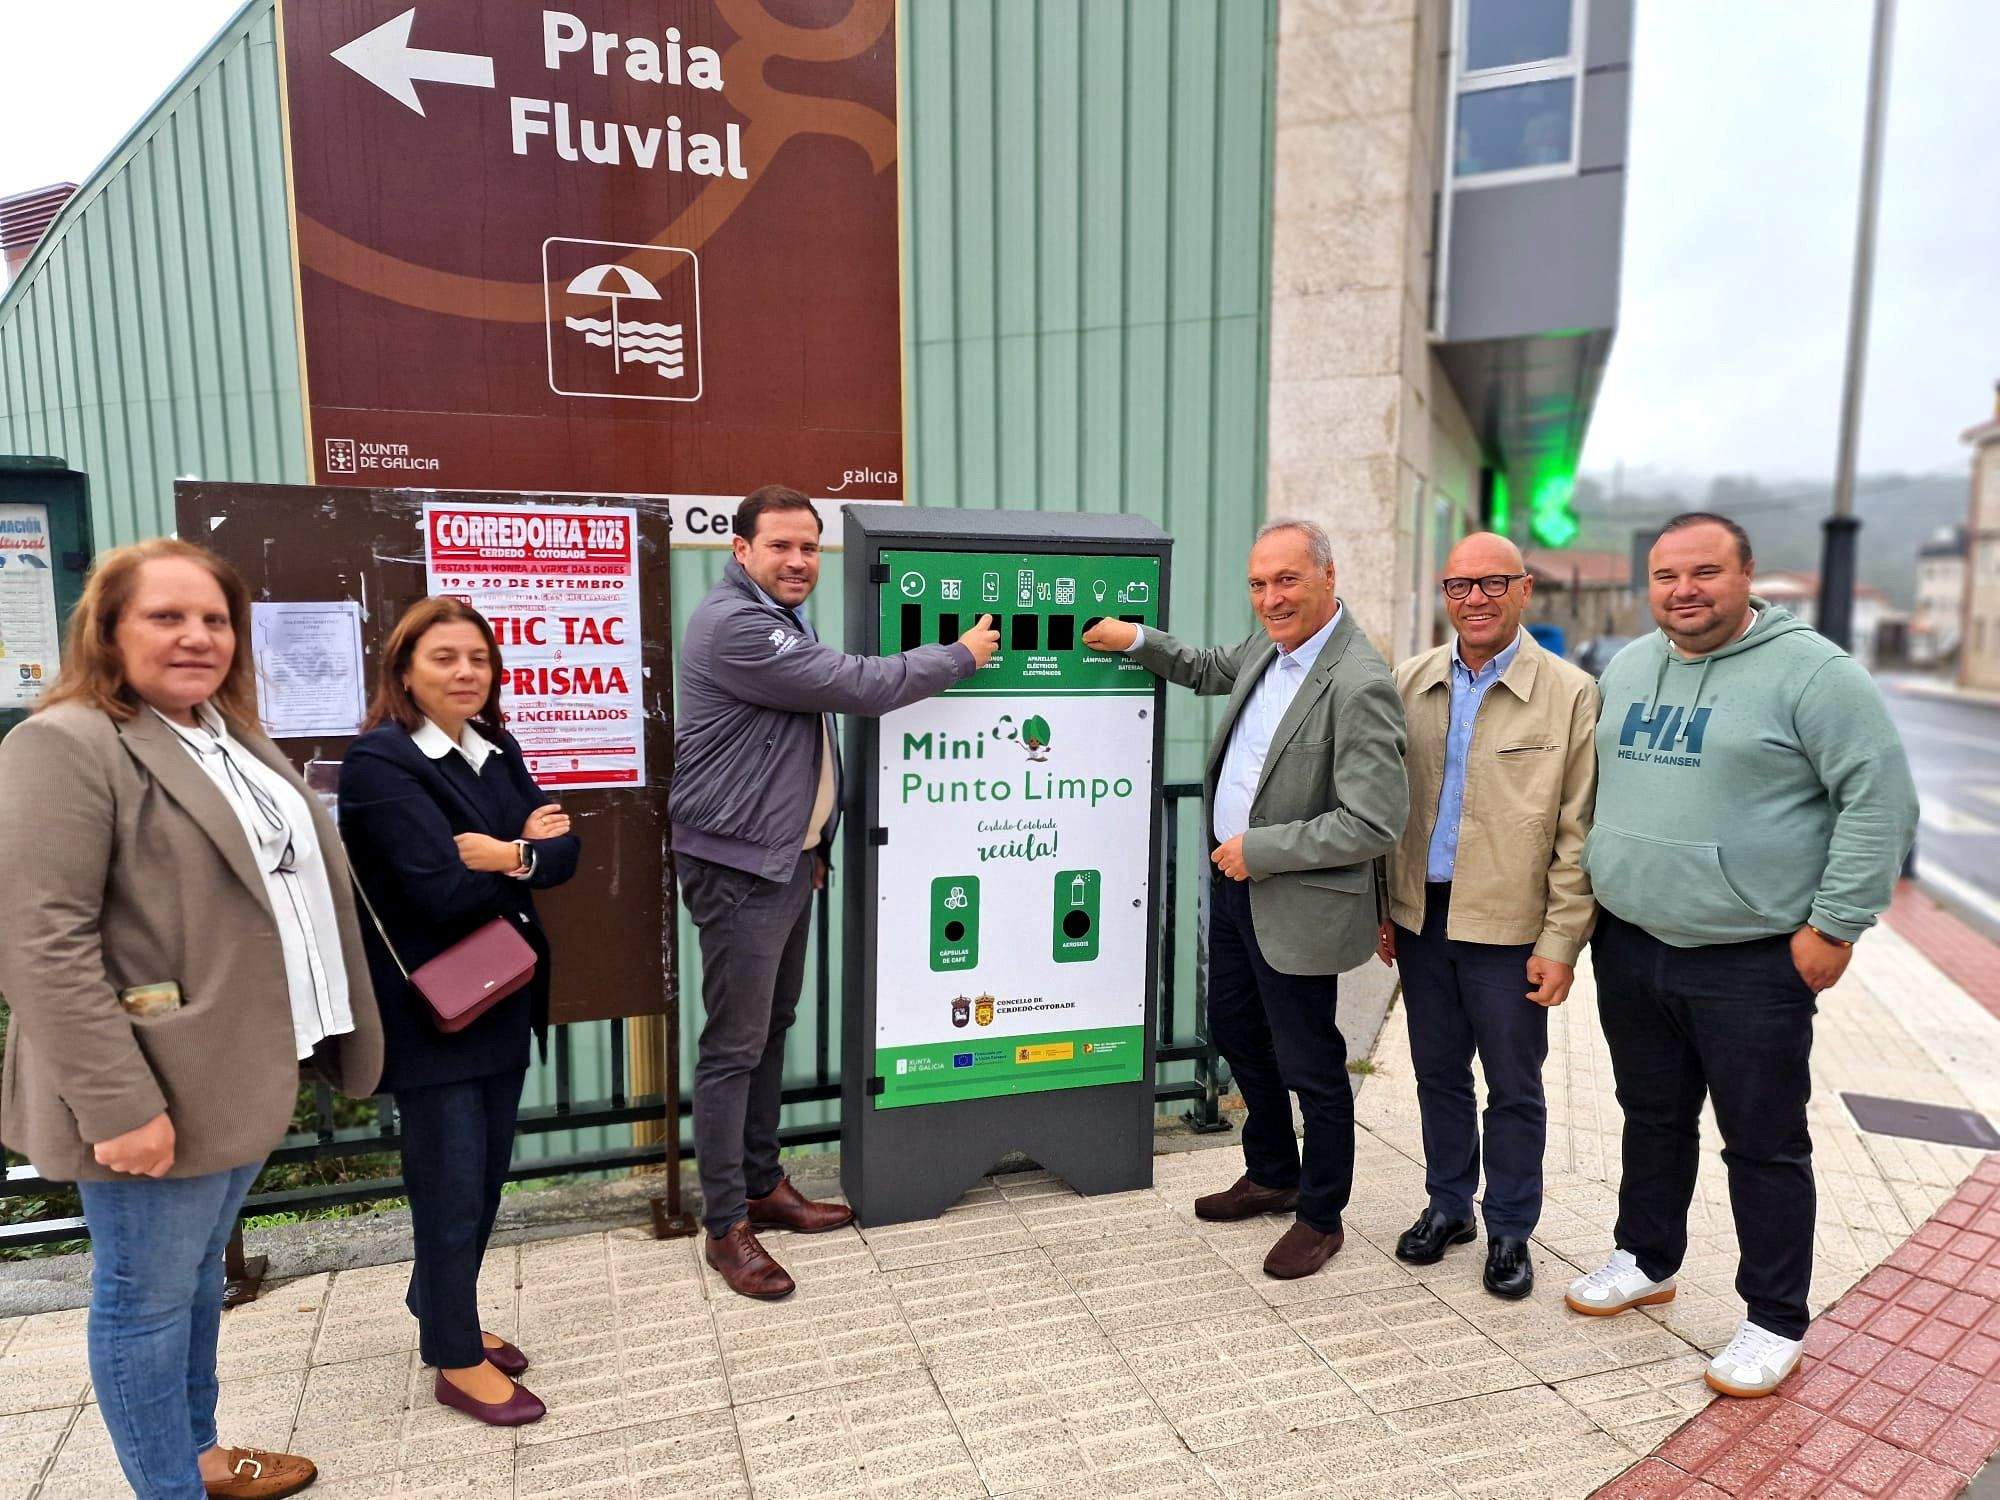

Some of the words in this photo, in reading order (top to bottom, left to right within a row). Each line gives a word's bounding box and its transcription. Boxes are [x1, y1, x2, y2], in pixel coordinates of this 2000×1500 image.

[543, 10, 725, 92] Praia
[510, 96, 748, 180] Fluvial
[360, 443, 408, 456] XUNTA
[360, 457, 378, 468] DE
[381, 458, 440, 470] GALICIA
[826, 466, 898, 491] galicia
[436, 515, 584, 549] CORREDOIRA
[587, 519, 625, 550] 2025
[479, 548, 525, 558] CERDEDO
[534, 549, 586, 559] COTOBADE
[435, 563, 471, 573] FESTAS
[474, 564, 488, 573] NA
[531, 564, 538, 573] A
[540, 564, 569, 573] VIRXE
[572, 565, 590, 574] DAS
[593, 565, 625, 574] DORES
[442, 578, 460, 588] 19
[467, 580, 476, 588] e
[482, 578, 502, 588] 20
[508, 578, 530, 588] DE
[536, 578, 624, 589] SETEMBRO
[488, 617, 546, 645] TIC
[559, 617, 624, 645] TAC
[517, 709, 628, 722] ENCERELLADOS
[903, 732, 984, 761] Mini
[1617, 750, 1651, 762] HELLY
[1654, 754, 1701, 767] HANSEN
[903, 773, 1011, 804] Punto
[1025, 771, 1133, 807] Limpo
[977, 830, 1058, 862] recicla!
[939, 949, 969, 957] CÁPSULAS
[996, 1002, 1076, 1014] CERDEDO-COTOBADE
[997, 998, 1032, 1006] CONCELLO
[908, 1058, 931, 1066] XUNTA
[919, 1063, 945, 1072] GALICIA
